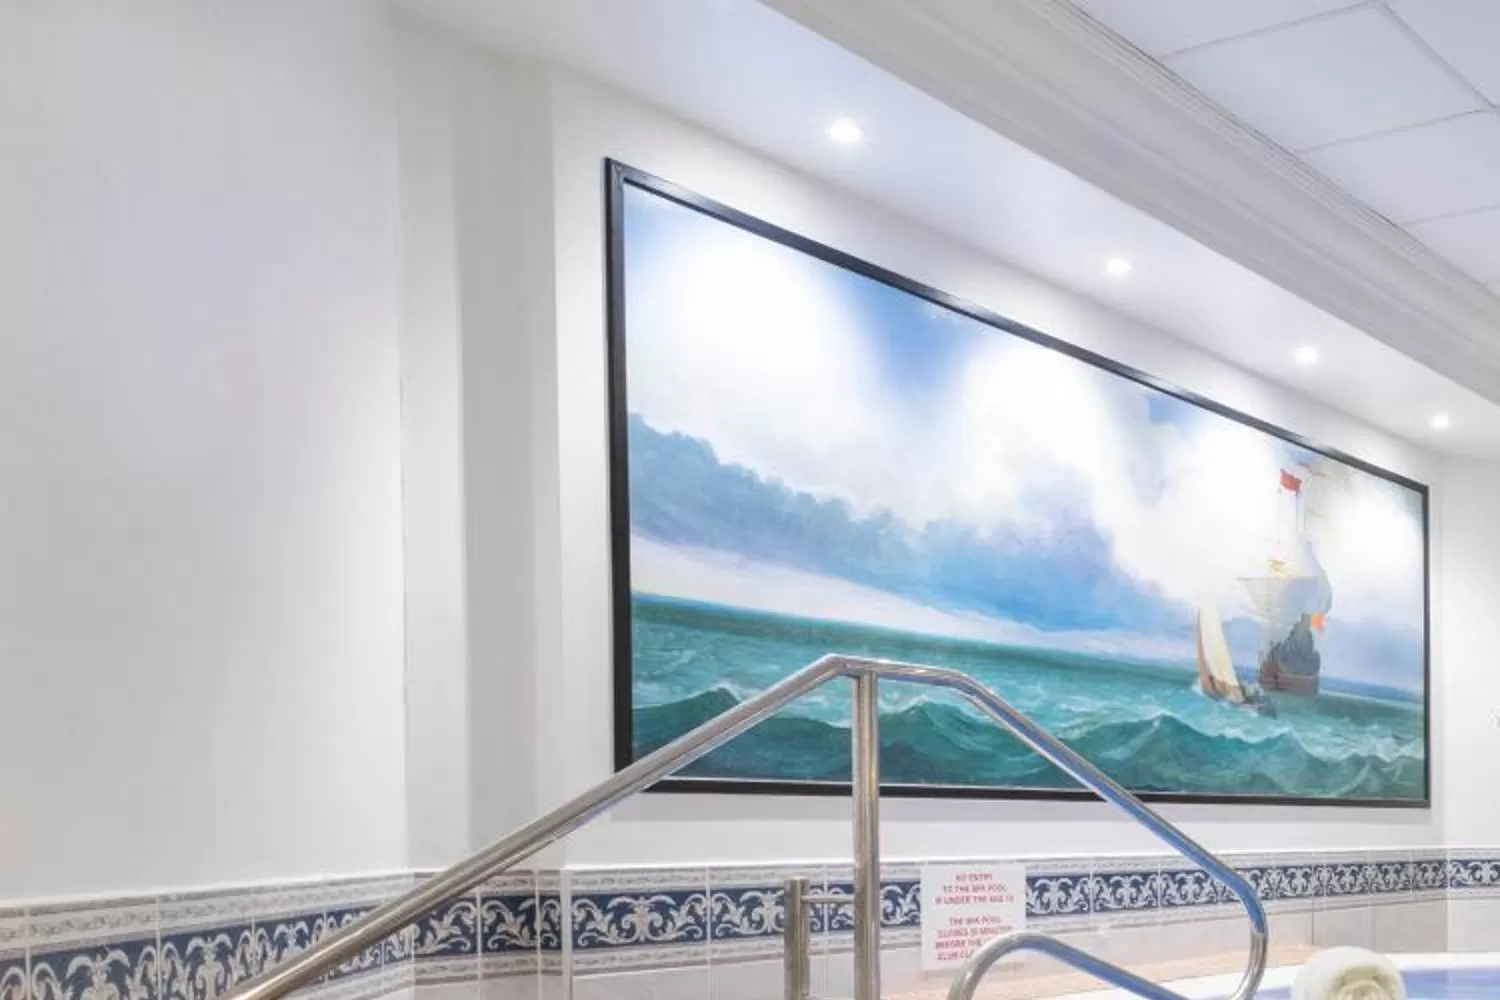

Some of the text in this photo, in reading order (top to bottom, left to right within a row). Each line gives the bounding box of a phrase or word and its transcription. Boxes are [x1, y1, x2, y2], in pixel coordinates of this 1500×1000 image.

[955, 884, 969, 893] THE
[944, 896, 970, 904] UNDER
[973, 895, 987, 903] THE
[949, 916, 963, 925] THE
